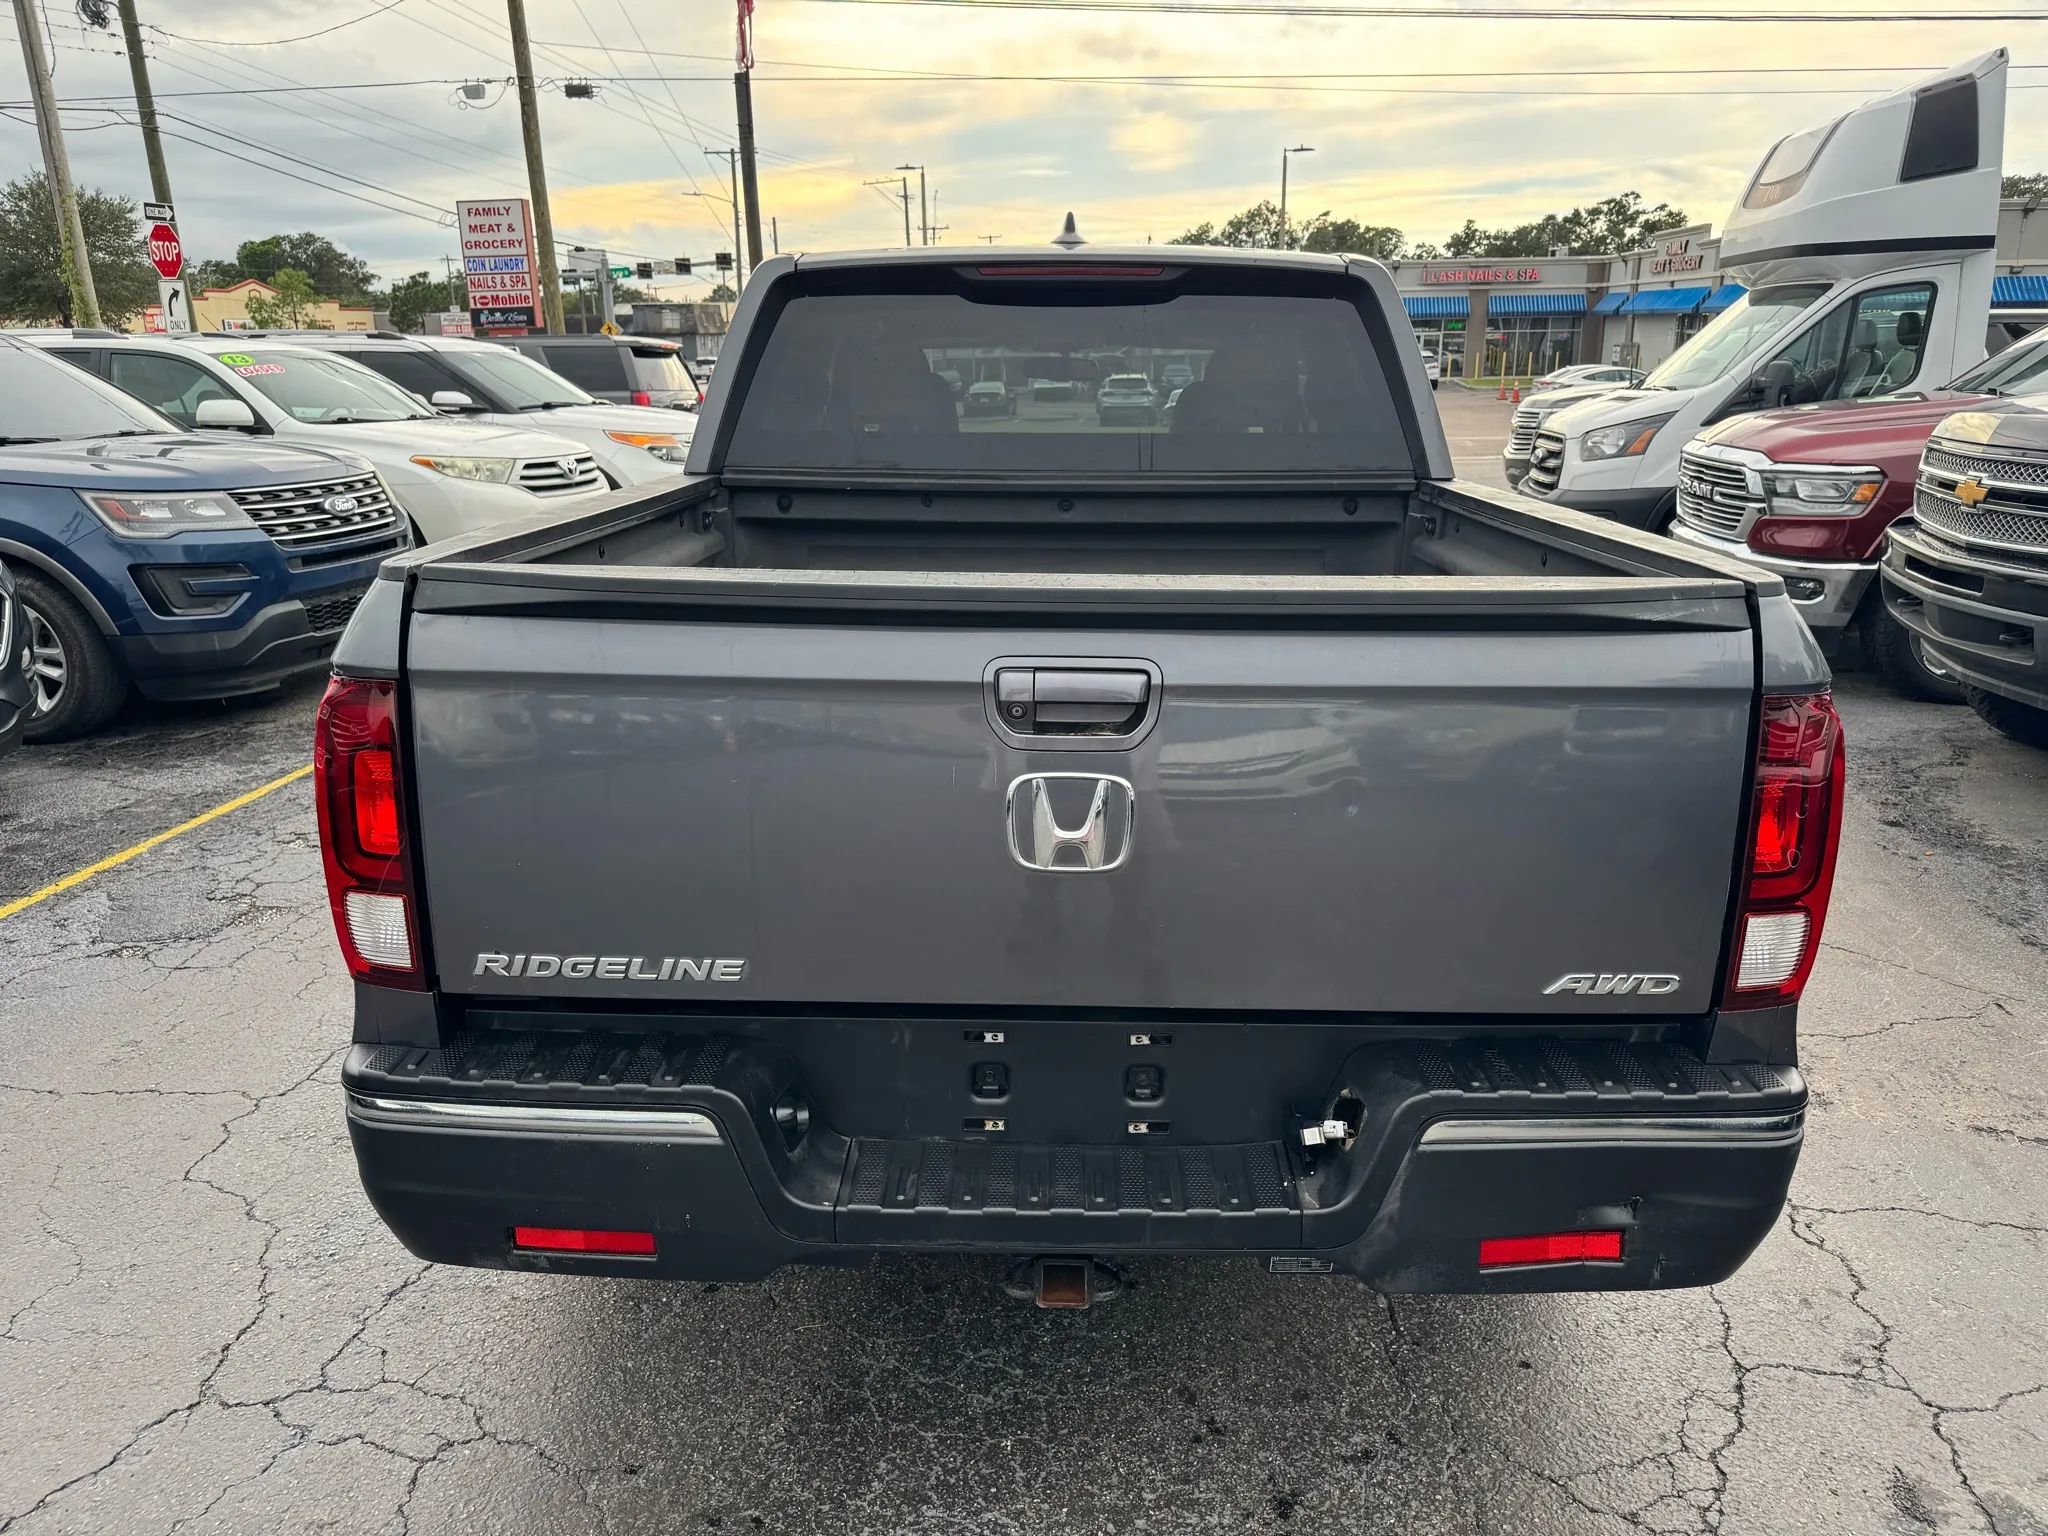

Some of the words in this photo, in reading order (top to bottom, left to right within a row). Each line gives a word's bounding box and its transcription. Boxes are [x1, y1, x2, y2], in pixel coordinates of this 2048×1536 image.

[147, 207, 157, 216] ONE
[158, 208, 167, 217] WAY
[467, 206, 511, 217] FAMILY
[468, 223, 502, 234] MEAT
[507, 222, 516, 233] &
[151, 240, 179, 262] STOP
[464, 239, 523, 250] GROCERY
[467, 259, 487, 272] COIN
[488, 257, 525, 271] LAUNDRY
[1431, 270, 1464, 283] LASH
[1467, 268, 1503, 282] NAILS
[1505, 267, 1517, 281] &
[1518, 266, 1541, 281] SPA
[470, 276, 498, 289] NAILS
[500, 275, 507, 289] &
[509, 275, 528, 288] SPA
[490, 293, 531, 306] Mobile
[170, 319, 187, 330] ONLY
[1680, 476, 1712, 498] RAM
[335, 498, 353, 511] Ford
[473, 953, 747, 982] RIDGELINE
[1541, 973, 1681, 996] AWD
